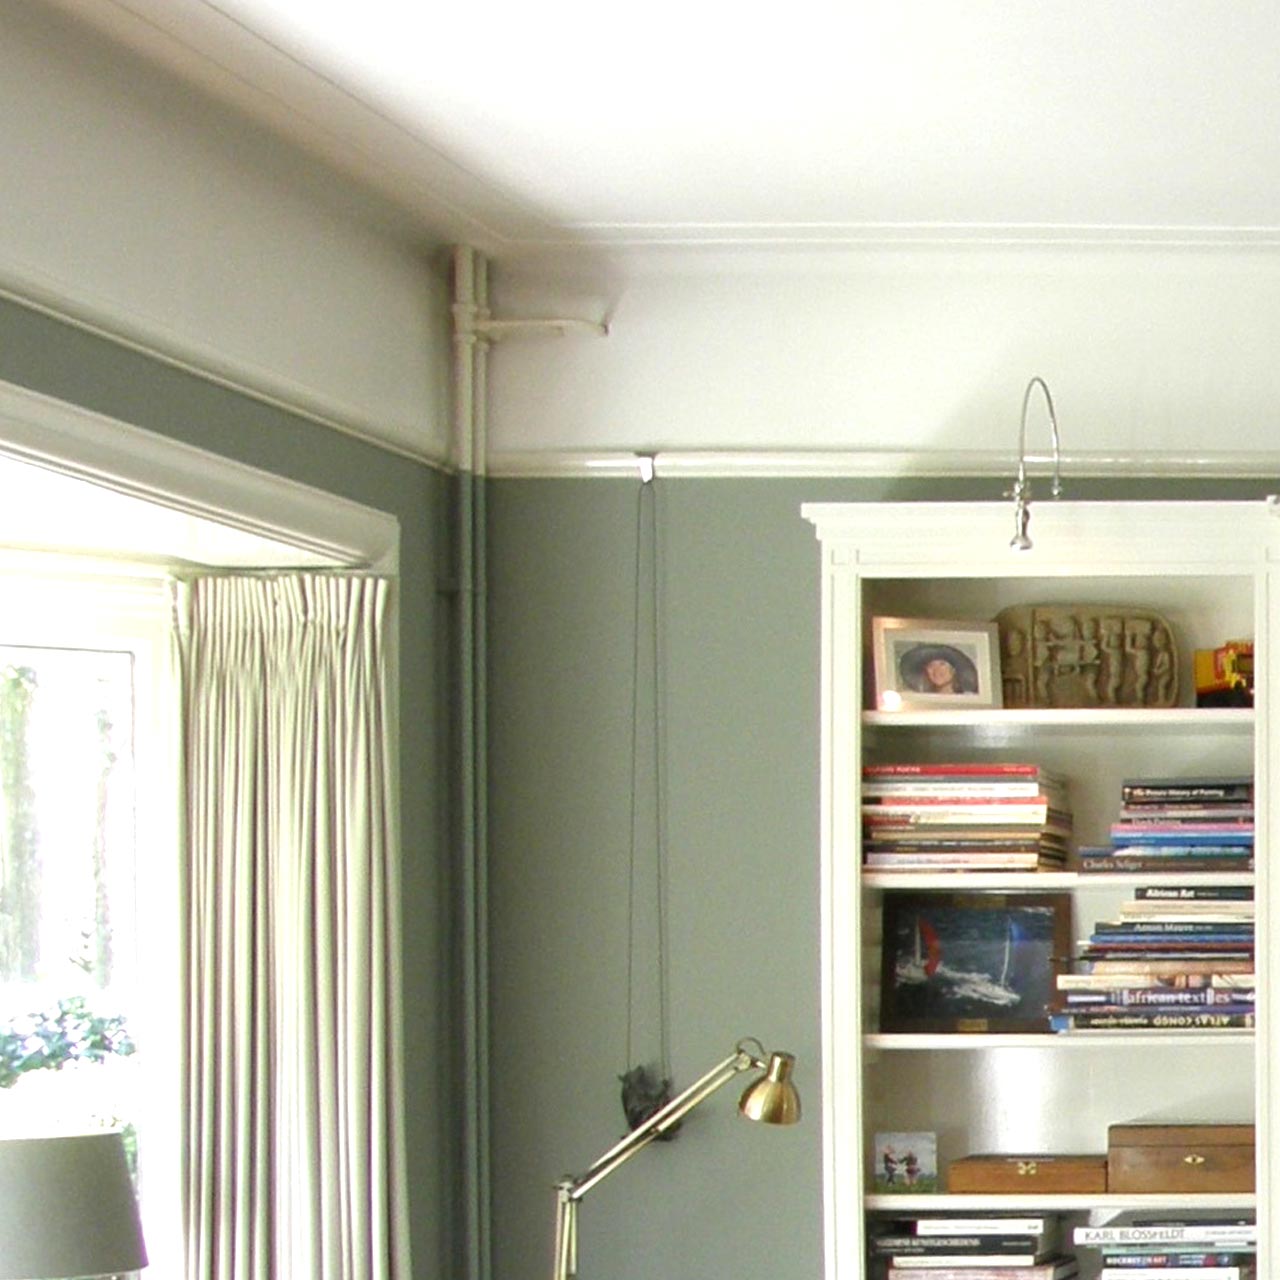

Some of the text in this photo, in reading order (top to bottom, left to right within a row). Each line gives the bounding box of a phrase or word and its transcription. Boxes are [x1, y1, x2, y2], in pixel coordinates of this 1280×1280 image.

[1083, 857, 1114, 870] Charles
[1146, 889, 1177, 898] African
[1180, 889, 1195, 898] Art
[1152, 1016, 1193, 1027] CONGO
[1195, 1015, 1231, 1026] ATLAS
[1085, 1229, 1186, 1241] KARL BLOSSFELDT
